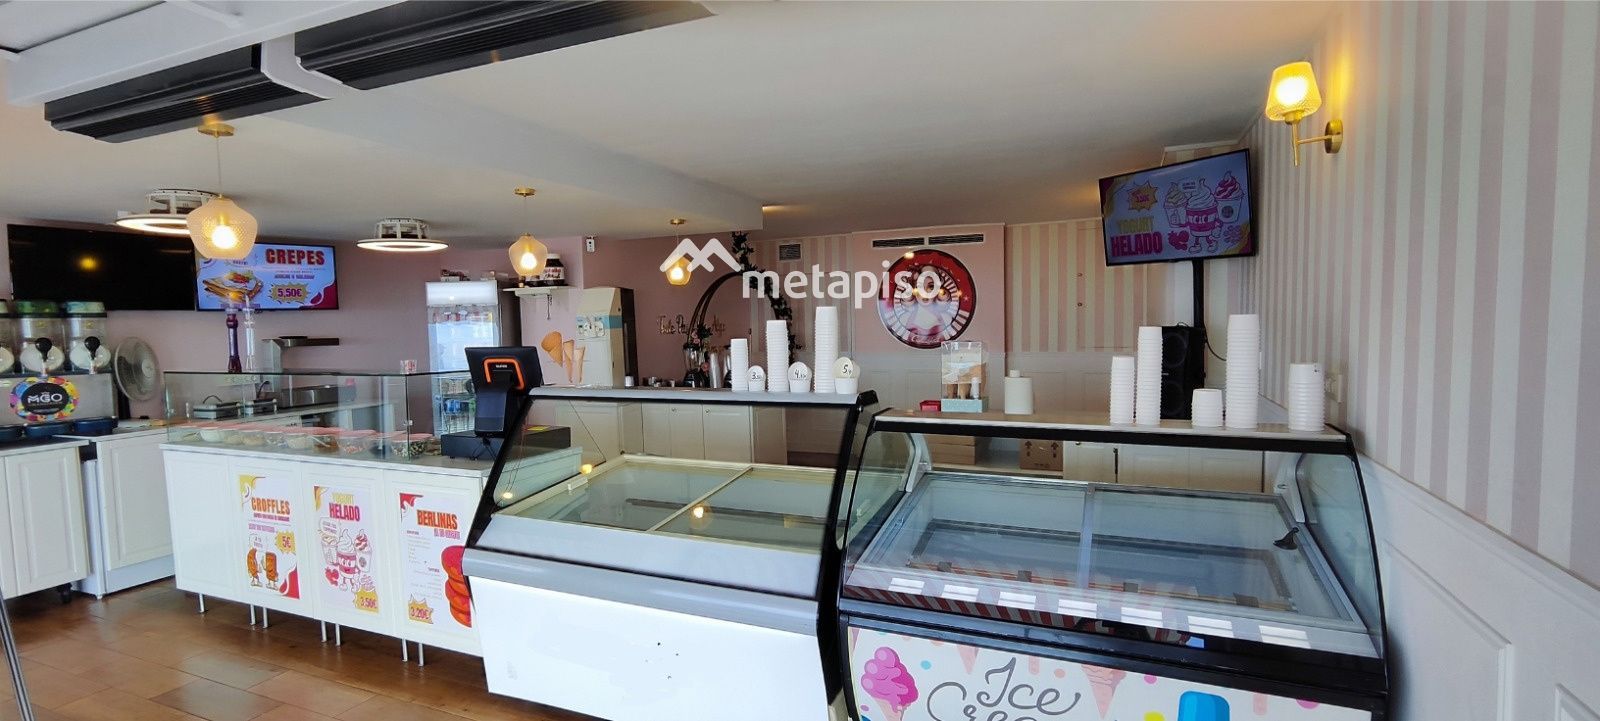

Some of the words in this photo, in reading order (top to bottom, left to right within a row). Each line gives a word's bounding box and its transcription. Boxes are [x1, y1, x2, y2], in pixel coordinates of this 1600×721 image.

[1111, 231, 1163, 257] HELADO
[265, 248, 325, 265] CREPES
[251, 496, 290, 515] CROFFLES
[329, 502, 360, 522] HELADO
[416, 509, 458, 530] BERLINAS
[281, 535, 292, 548] 5€
[976, 656, 1082, 716] Ice
